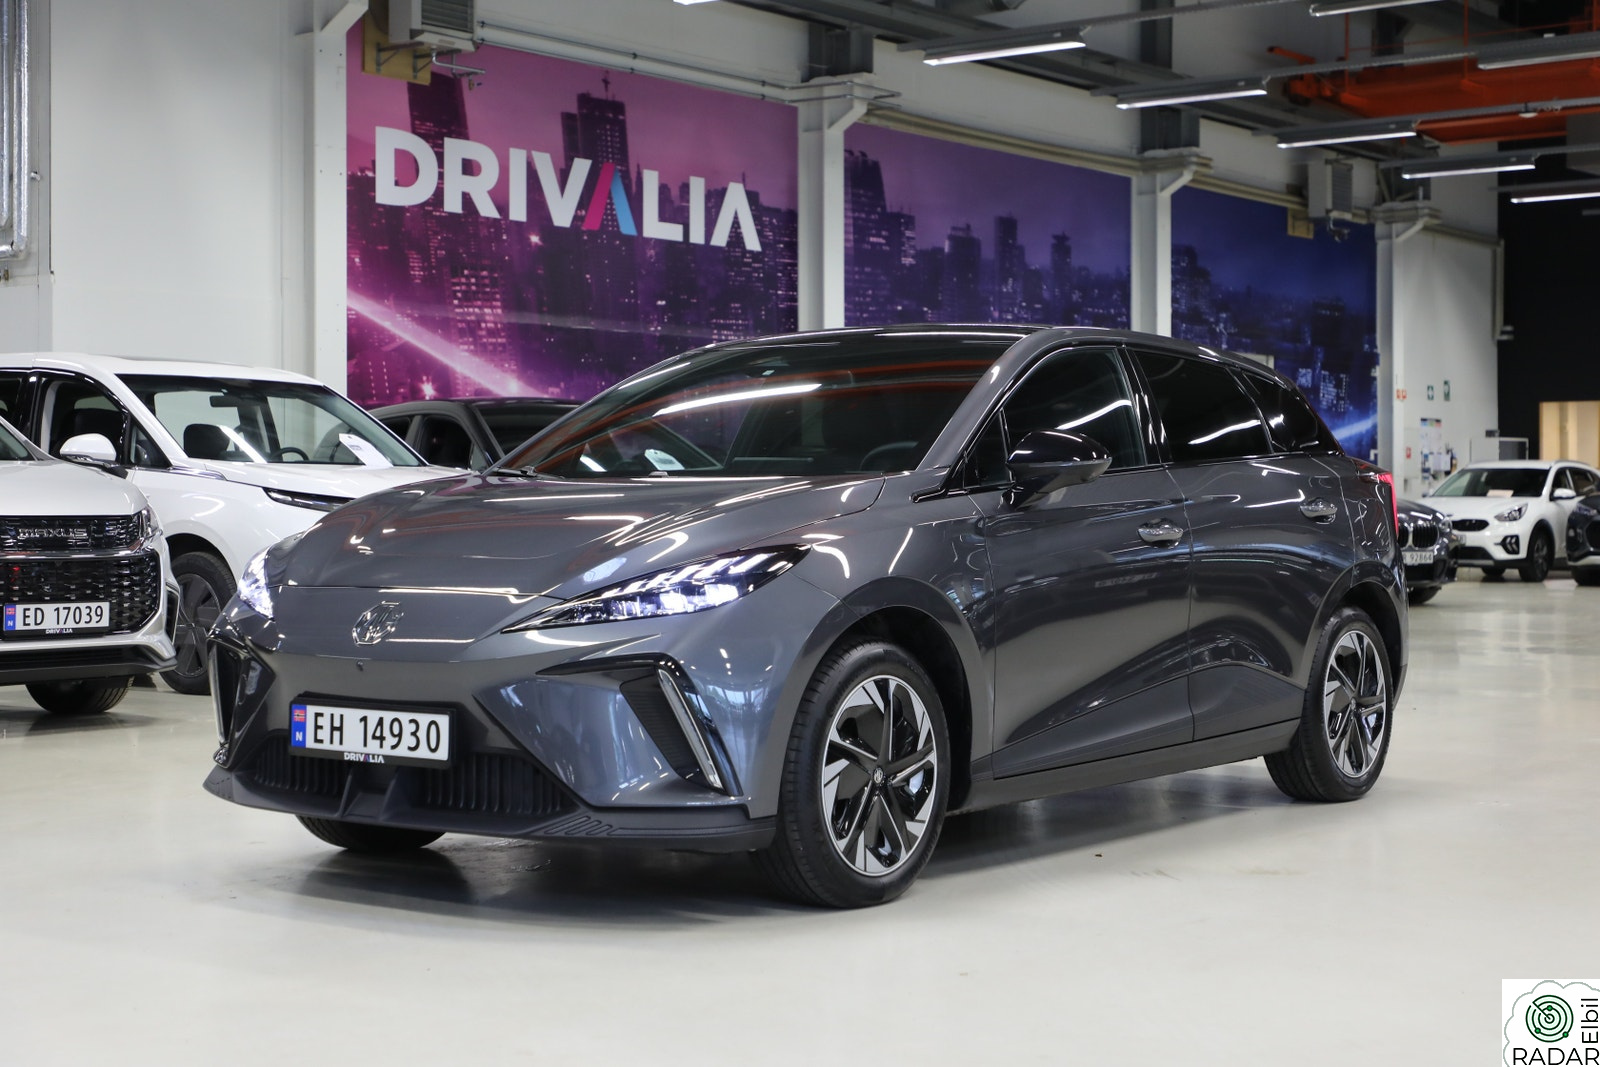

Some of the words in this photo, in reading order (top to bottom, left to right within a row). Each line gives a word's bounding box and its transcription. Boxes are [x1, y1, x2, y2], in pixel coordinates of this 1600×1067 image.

[375, 126, 762, 252] DRIVALIA
[22, 607, 45, 626] ED
[54, 605, 104, 625] 17039
[295, 732, 303, 741] N
[313, 712, 344, 745] EH
[359, 715, 441, 753] 14930
[344, 752, 384, 764] DRIVALIA
